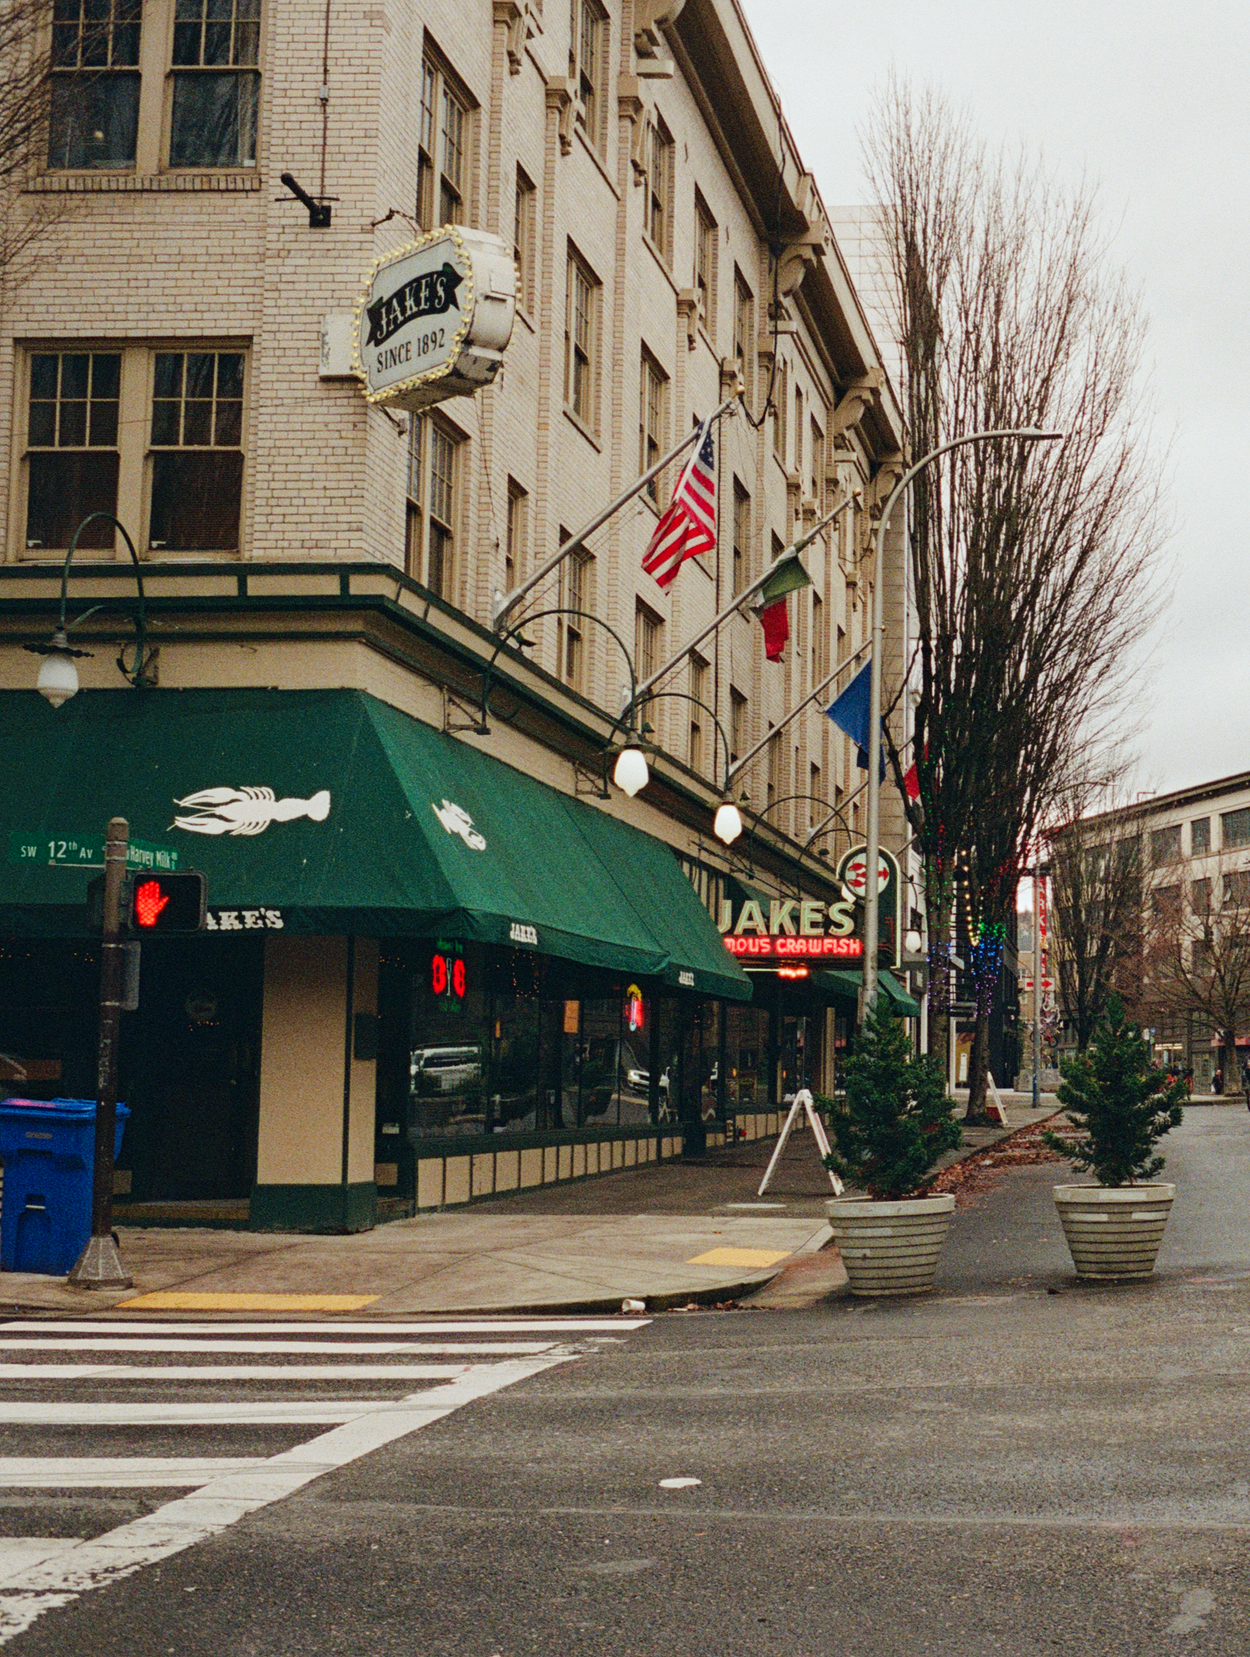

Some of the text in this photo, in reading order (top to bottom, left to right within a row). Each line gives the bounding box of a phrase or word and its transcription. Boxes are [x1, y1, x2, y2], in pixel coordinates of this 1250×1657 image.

[377, 274, 446, 339] JAKE'S
[377, 328, 444, 373] SINCE 1892
[21, 846, 37, 858] SW
[48, 841, 78, 858] 12th
[130, 845, 153, 867] Harvey
[156, 851, 171, 869] Milk
[206, 907, 284, 930] AKE'S
[717, 900, 855, 936] JAKES
[775, 938, 861, 953] CRAWFISH
